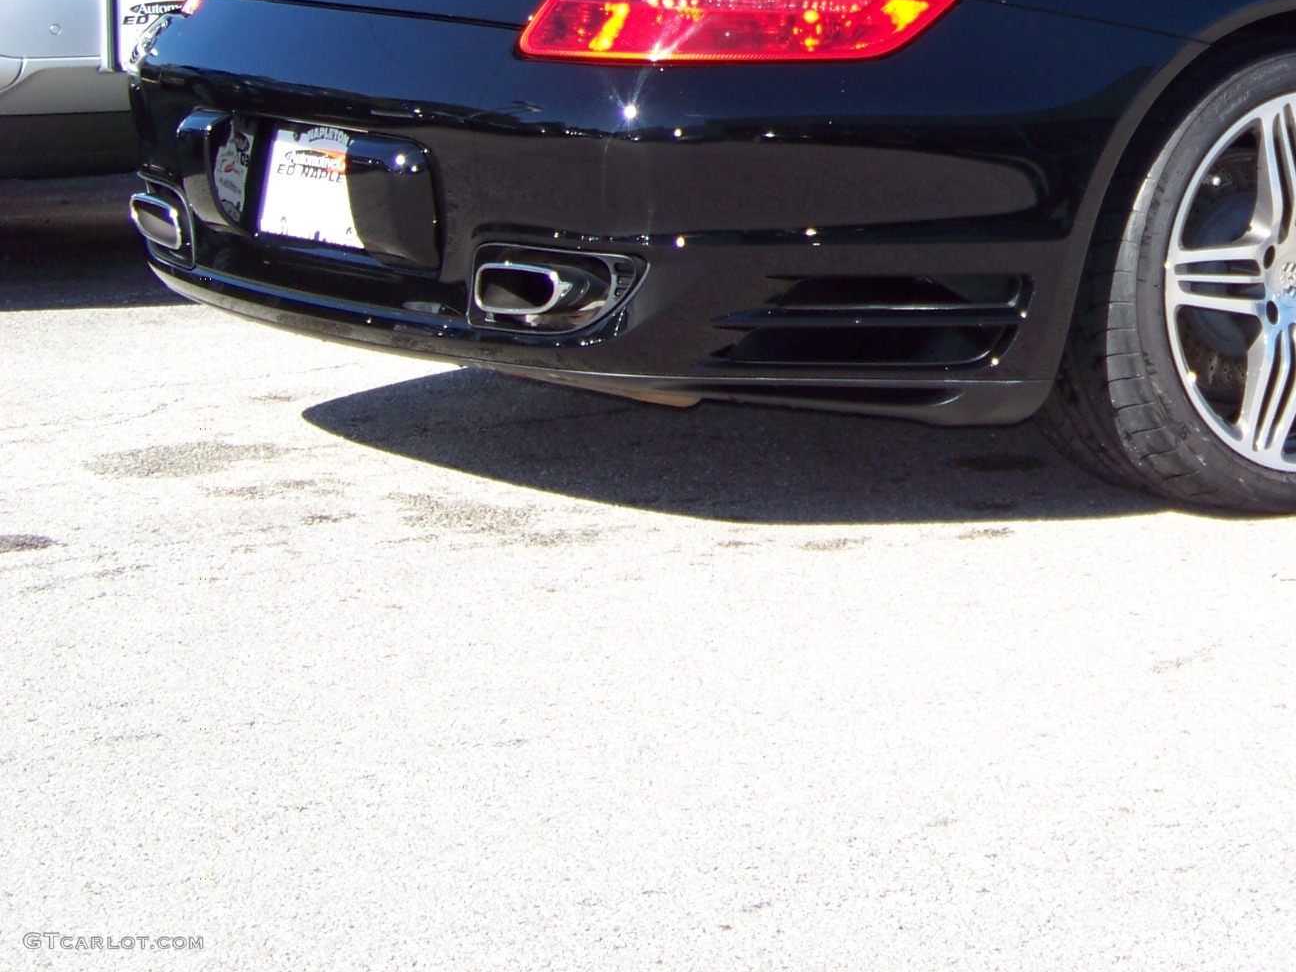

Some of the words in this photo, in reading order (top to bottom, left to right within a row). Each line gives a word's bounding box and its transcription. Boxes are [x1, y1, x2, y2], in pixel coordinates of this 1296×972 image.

[122, 14, 150, 26] ED
[277, 163, 296, 177] ED
[301, 165, 346, 184] NAPLE
